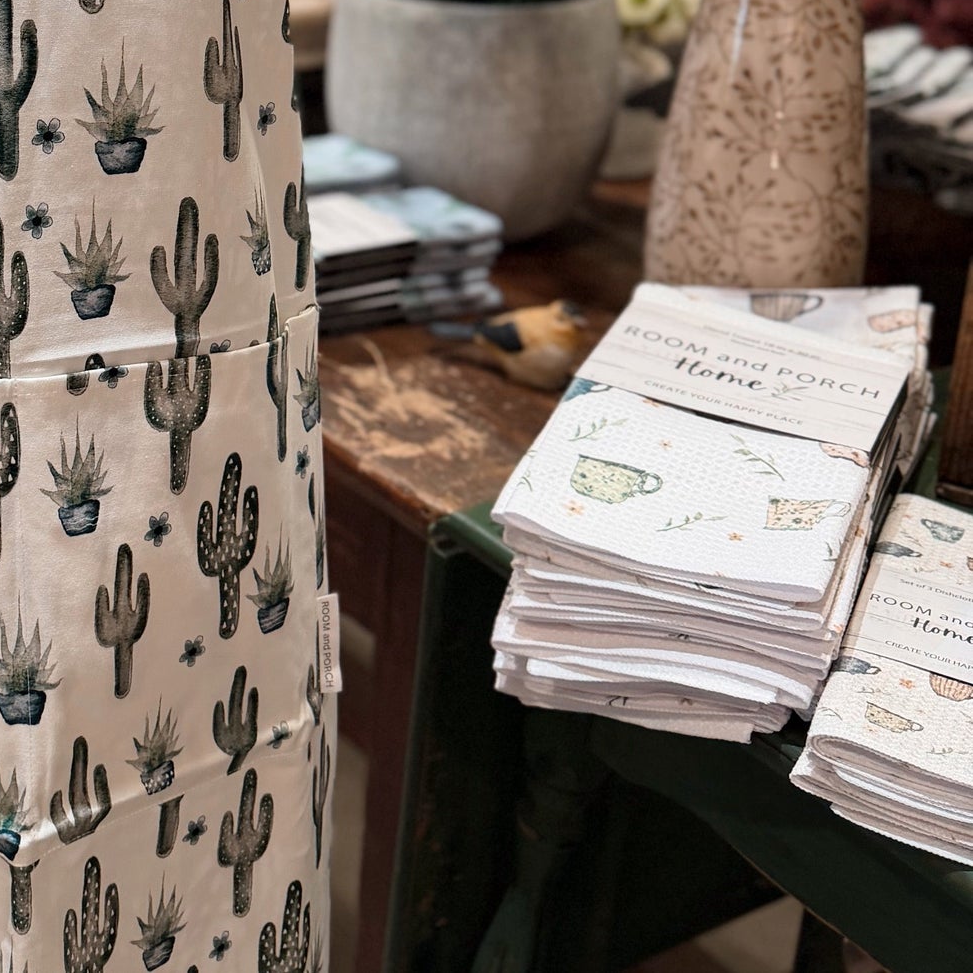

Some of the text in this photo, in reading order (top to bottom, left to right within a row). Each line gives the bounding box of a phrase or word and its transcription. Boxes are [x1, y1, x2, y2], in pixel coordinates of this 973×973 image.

[624, 325, 709, 356] ROOM
[717, 352, 769, 372] and
[777, 367, 880, 400] PORCH
[673, 357, 767, 391] Home
[644, 379, 804, 426] CREATE YOUR HAPPY PLACE
[900, 579, 914, 587] Set
[870, 593, 932, 617] ROOM
[321, 600, 334, 688] ROOM and PORCH
[885, 640, 922, 655] CREATE
[924, 651, 952, 664] YOUR
